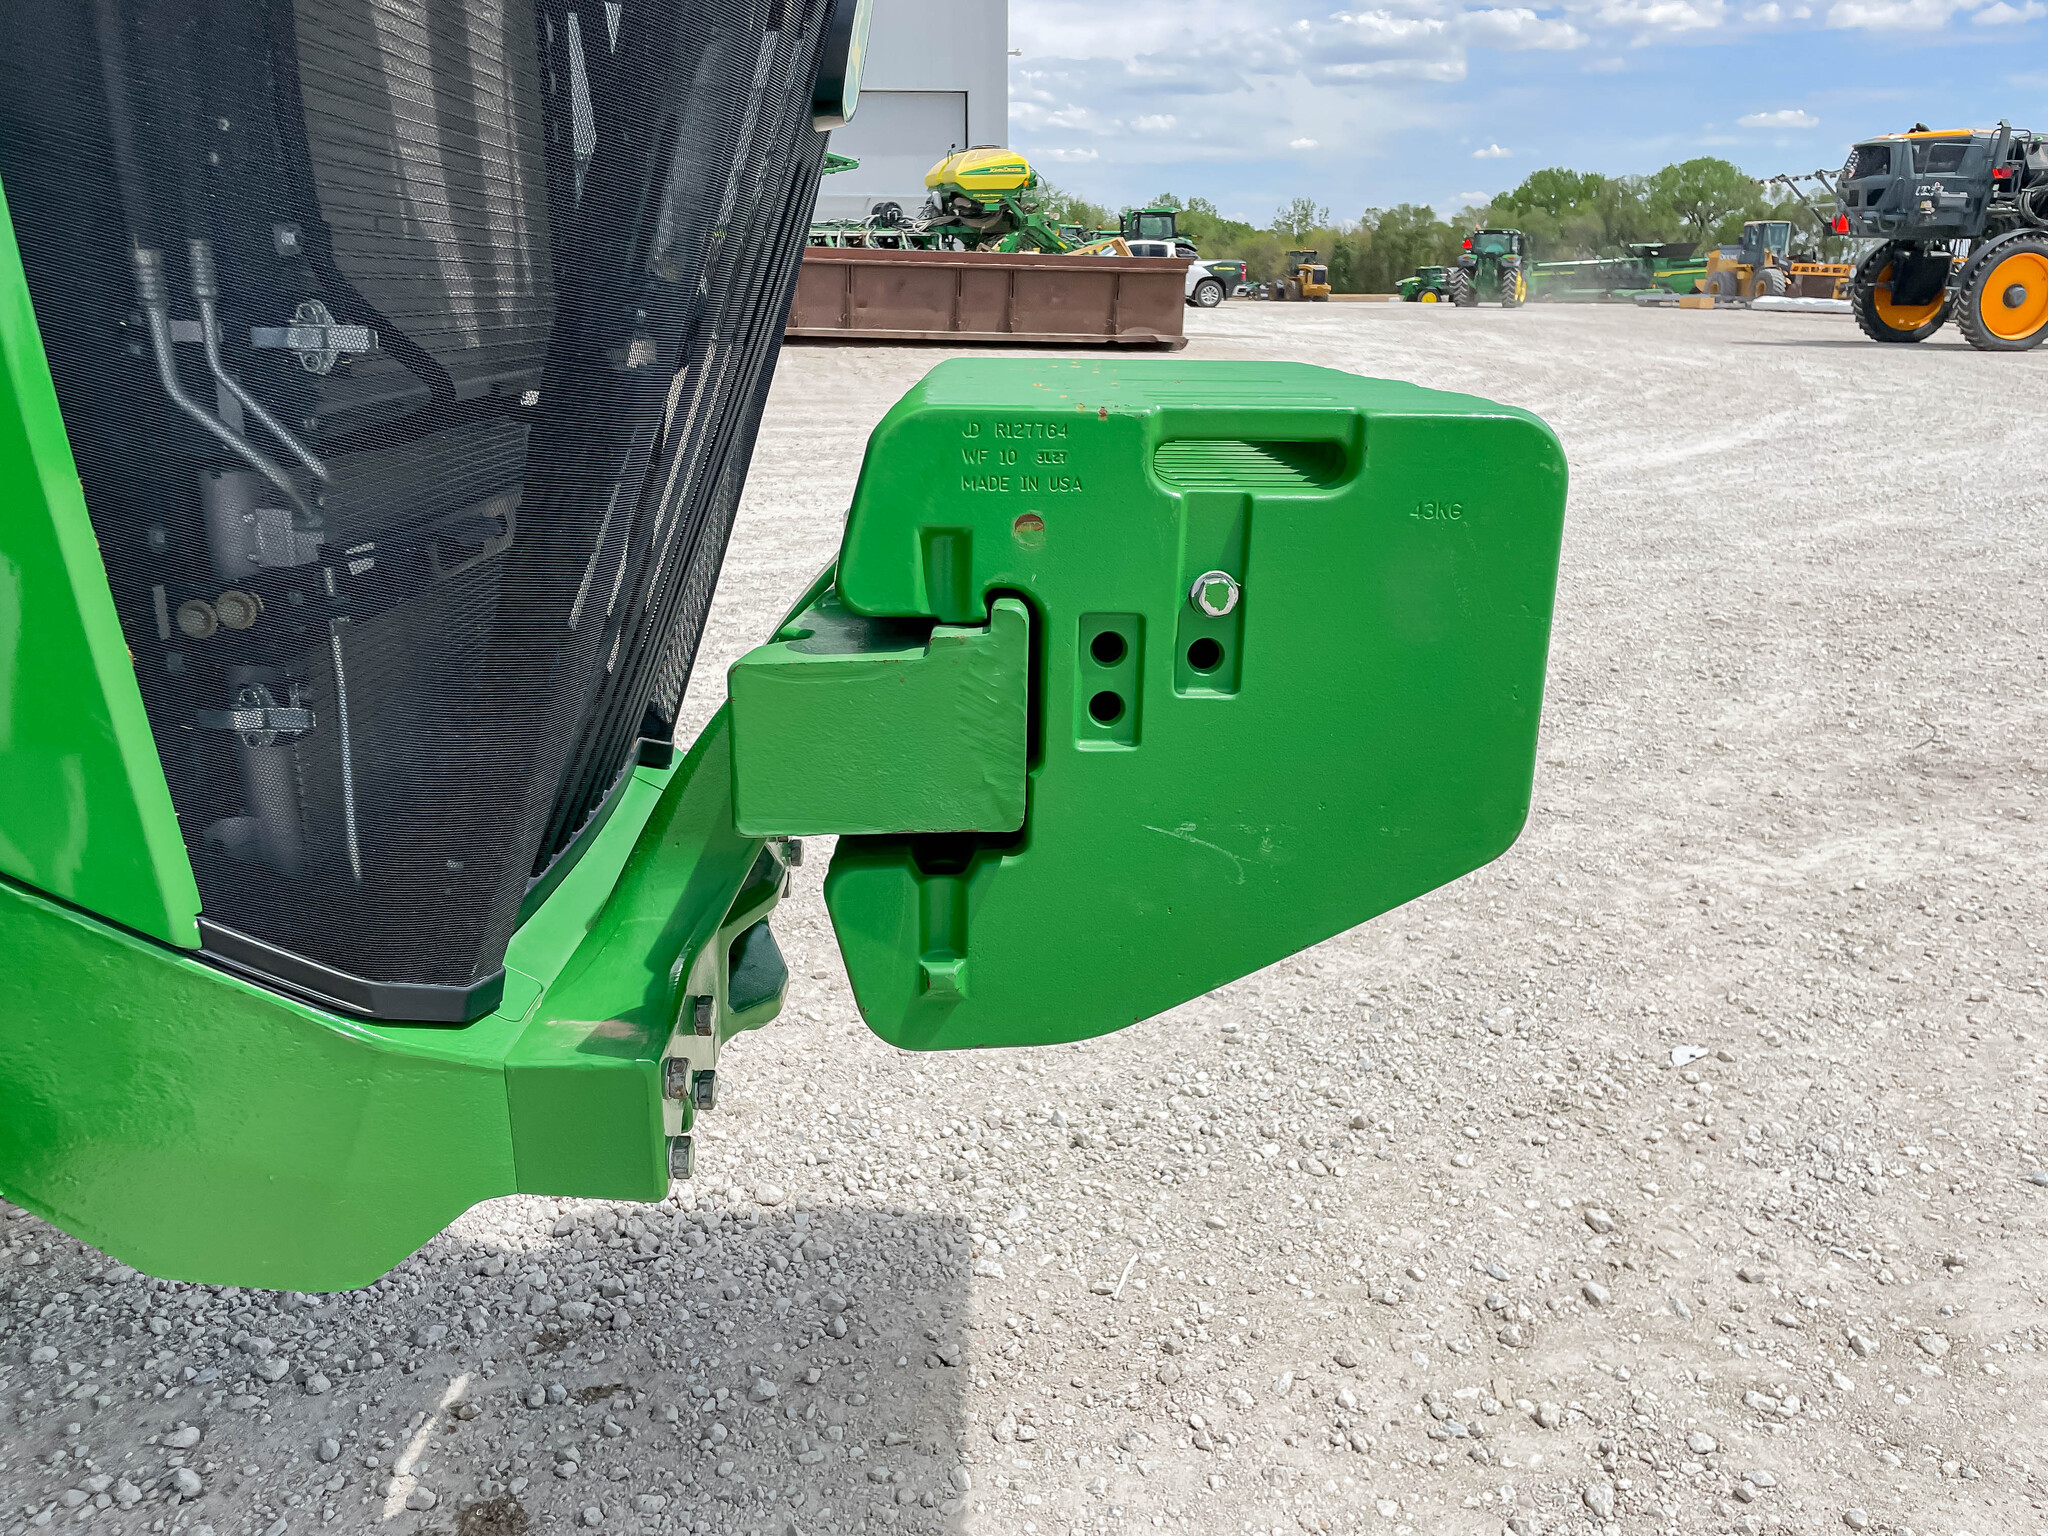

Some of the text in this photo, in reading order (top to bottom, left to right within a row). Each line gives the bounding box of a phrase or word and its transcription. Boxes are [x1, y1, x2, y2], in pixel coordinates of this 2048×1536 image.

[962, 422, 1068, 439] JD R127764
[961, 448, 989, 465] WF
[999, 449, 1018, 465] 10
[960, 475, 1083, 492] MADE IN USA
[1409, 501, 1463, 520] 43KG
